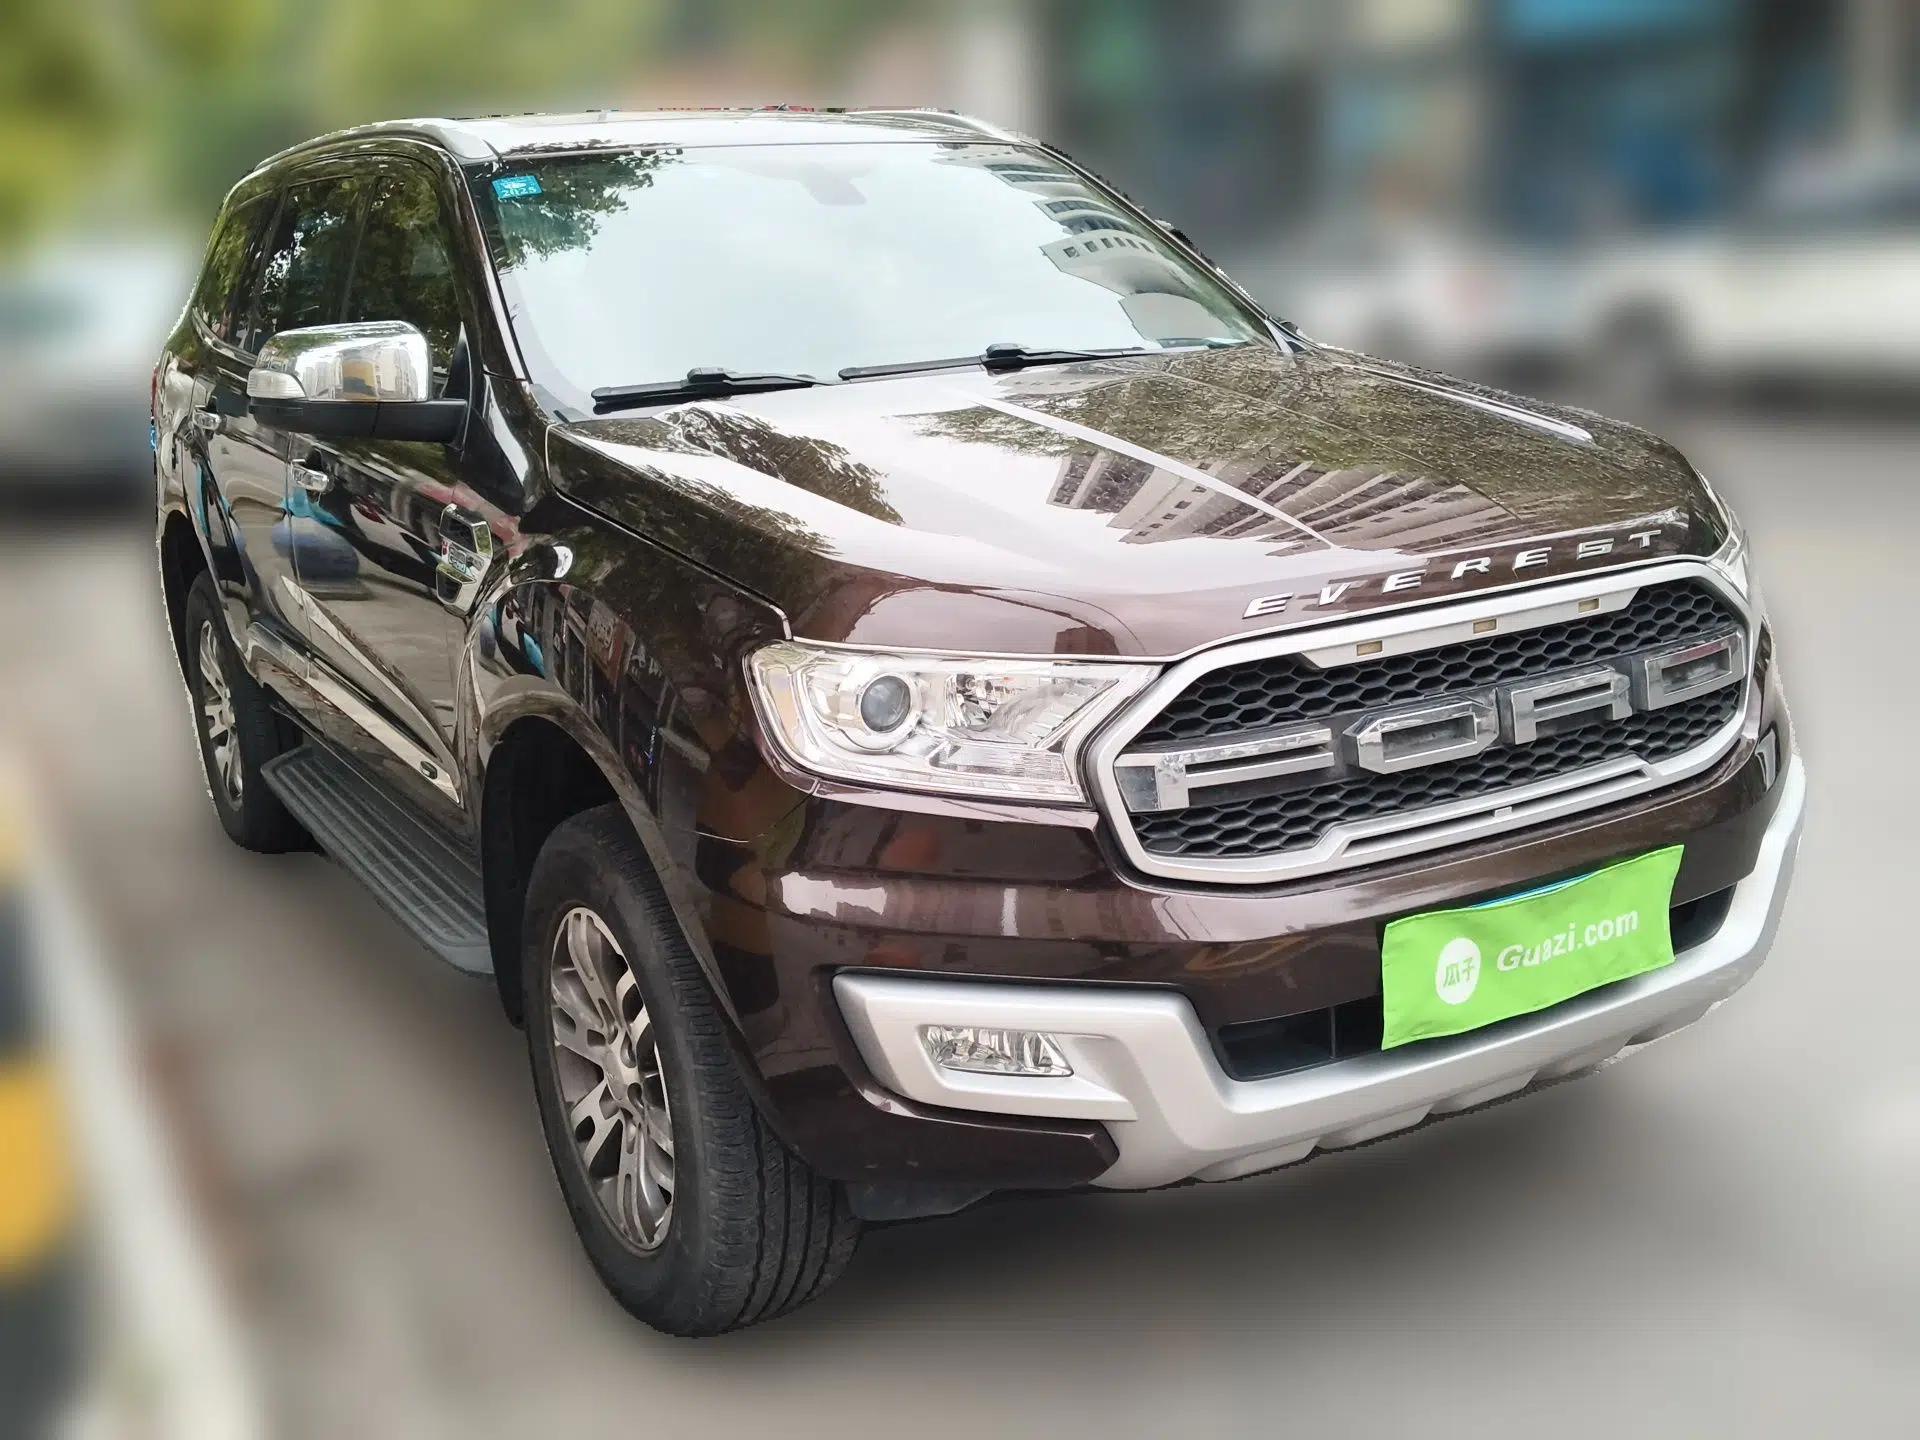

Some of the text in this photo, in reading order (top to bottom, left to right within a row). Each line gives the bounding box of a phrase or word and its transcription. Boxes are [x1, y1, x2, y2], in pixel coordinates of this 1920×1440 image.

[1243, 530, 1662, 618] EVEREST
[1115, 629, 1745, 811] FORD
[1442, 956, 1475, 988] 瓜子
[1497, 909, 1639, 972] Guazi.com
